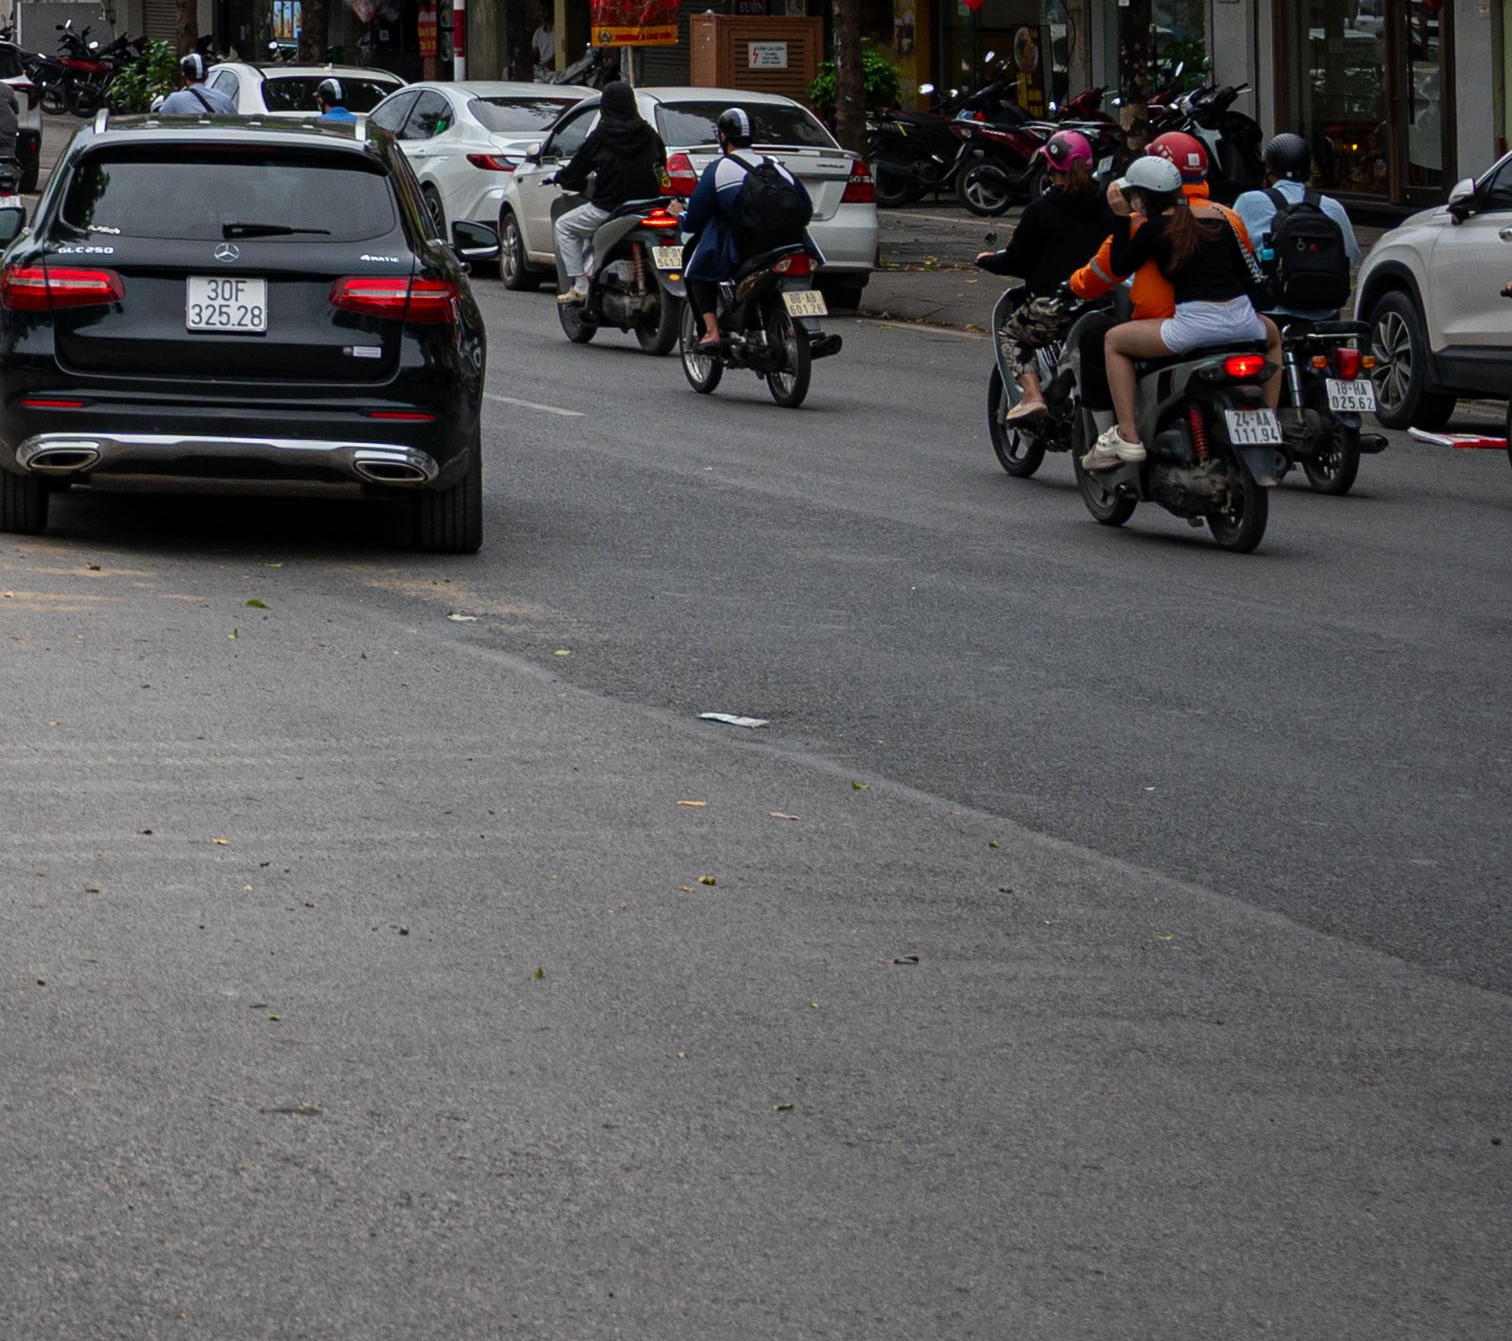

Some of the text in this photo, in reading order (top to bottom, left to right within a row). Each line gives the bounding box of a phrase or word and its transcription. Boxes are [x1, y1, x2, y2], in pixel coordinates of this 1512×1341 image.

[206, 279, 248, 302] 30F
[190, 304, 263, 328] 325.28
[1335, 381, 1368, 396] 18-HA
[1331, 395, 1374, 410] 025.62
[1233, 412, 1271, 427] 24-AA
[1234, 427, 1279, 443] 111.94
